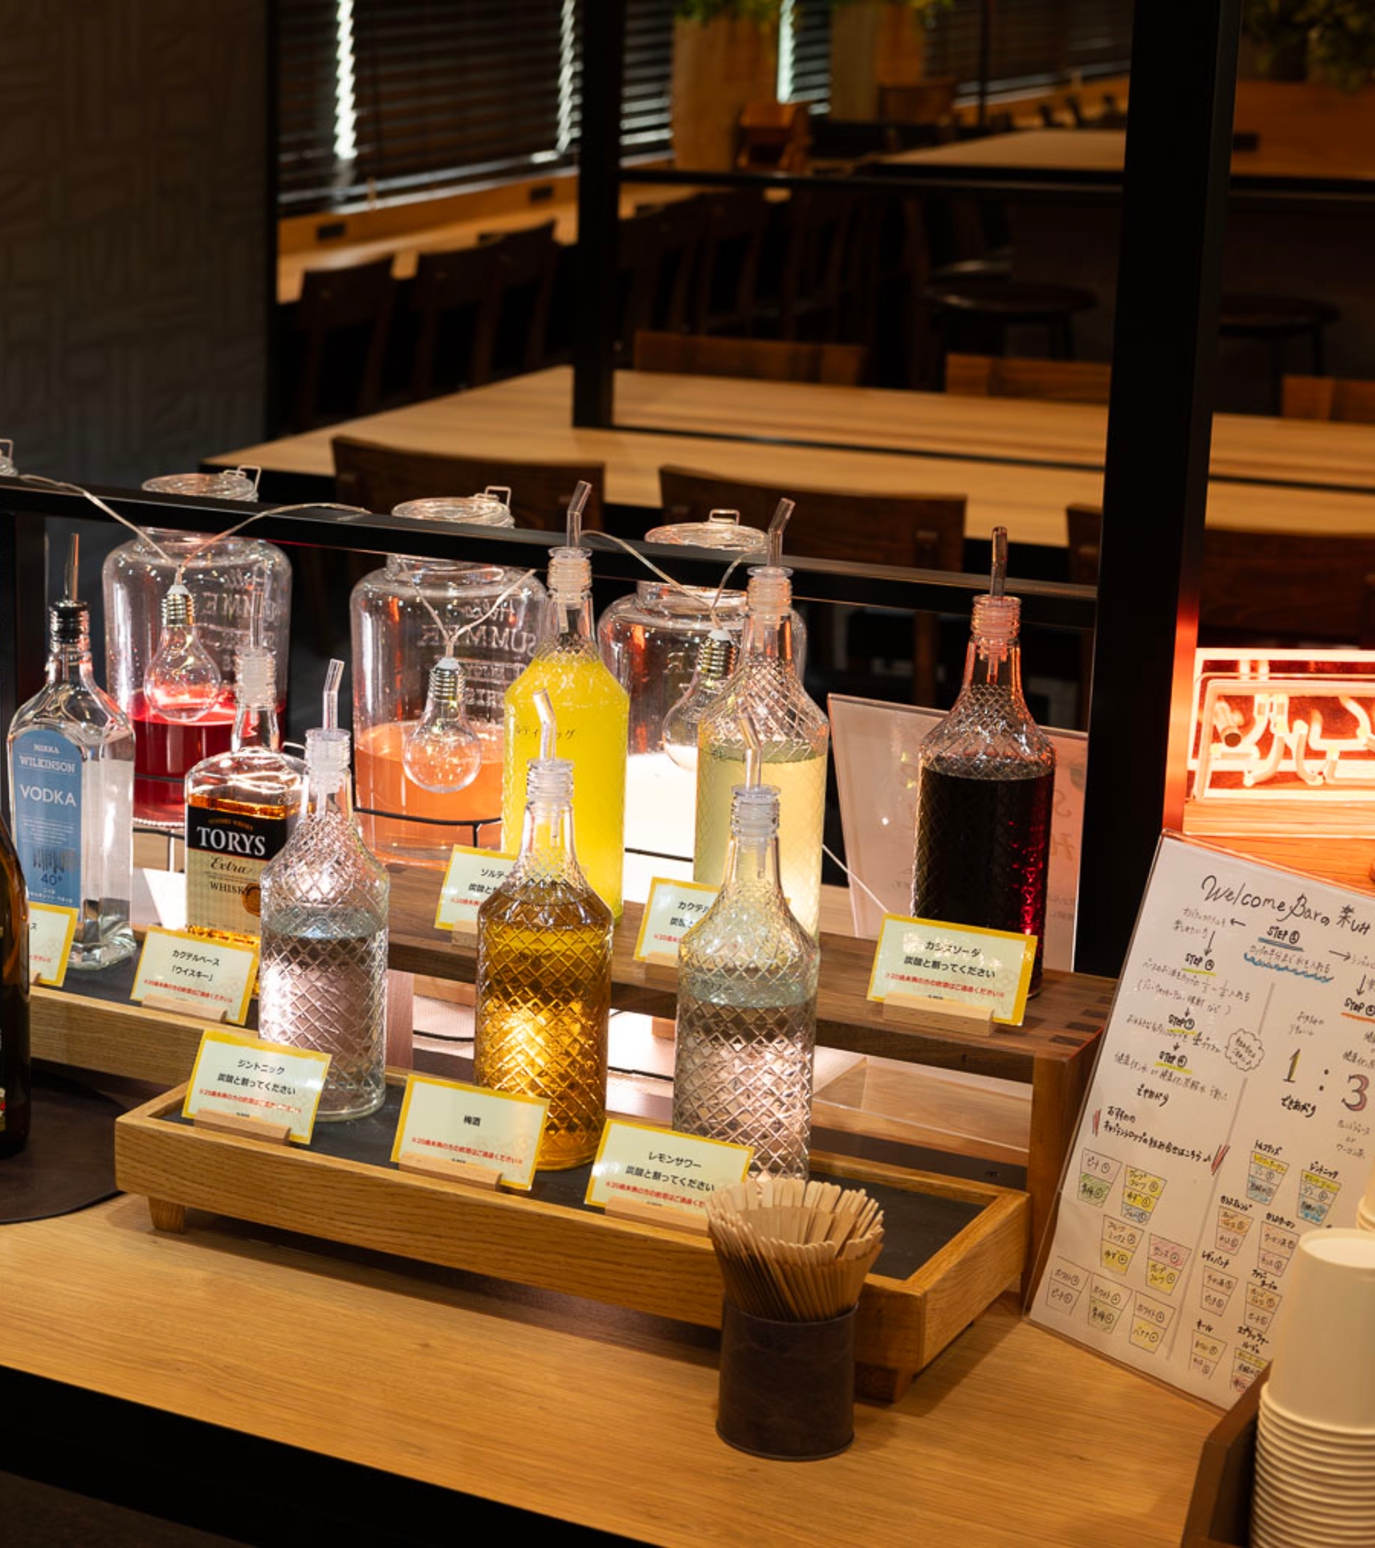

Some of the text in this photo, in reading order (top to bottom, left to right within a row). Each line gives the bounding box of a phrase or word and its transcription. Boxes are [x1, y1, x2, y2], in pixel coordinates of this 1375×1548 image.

[33, 743, 60, 755] NIKKA
[19, 755, 76, 774] WILKINSON
[19, 783, 77, 807] VODKA
[196, 826, 266, 857] TORYS
[209, 855, 252, 875] Extra
[1201, 875, 1286, 912] Welcome
[1267, 925, 1288, 941] STEP
[925, 940, 983, 957] カシスソーダ
[172, 949, 220, 967] カクテルベース
[903, 955, 995, 978] 炭酸と割ってください
[1185, 953, 1203, 967] STEP
[1344, 997, 1364, 1013] STEP
[237, 1059, 285, 1075] ジントニック
[217, 1072, 296, 1096] 炭酸と割ってください
[1282, 1048, 1301, 1083] 1
[1341, 1073, 1370, 1112] 3
[463, 1115, 481, 1127] 梅酒
[648, 1151, 702, 1169] レモンサワー
[626, 1165, 715, 1192] 炭酸と割ってください
